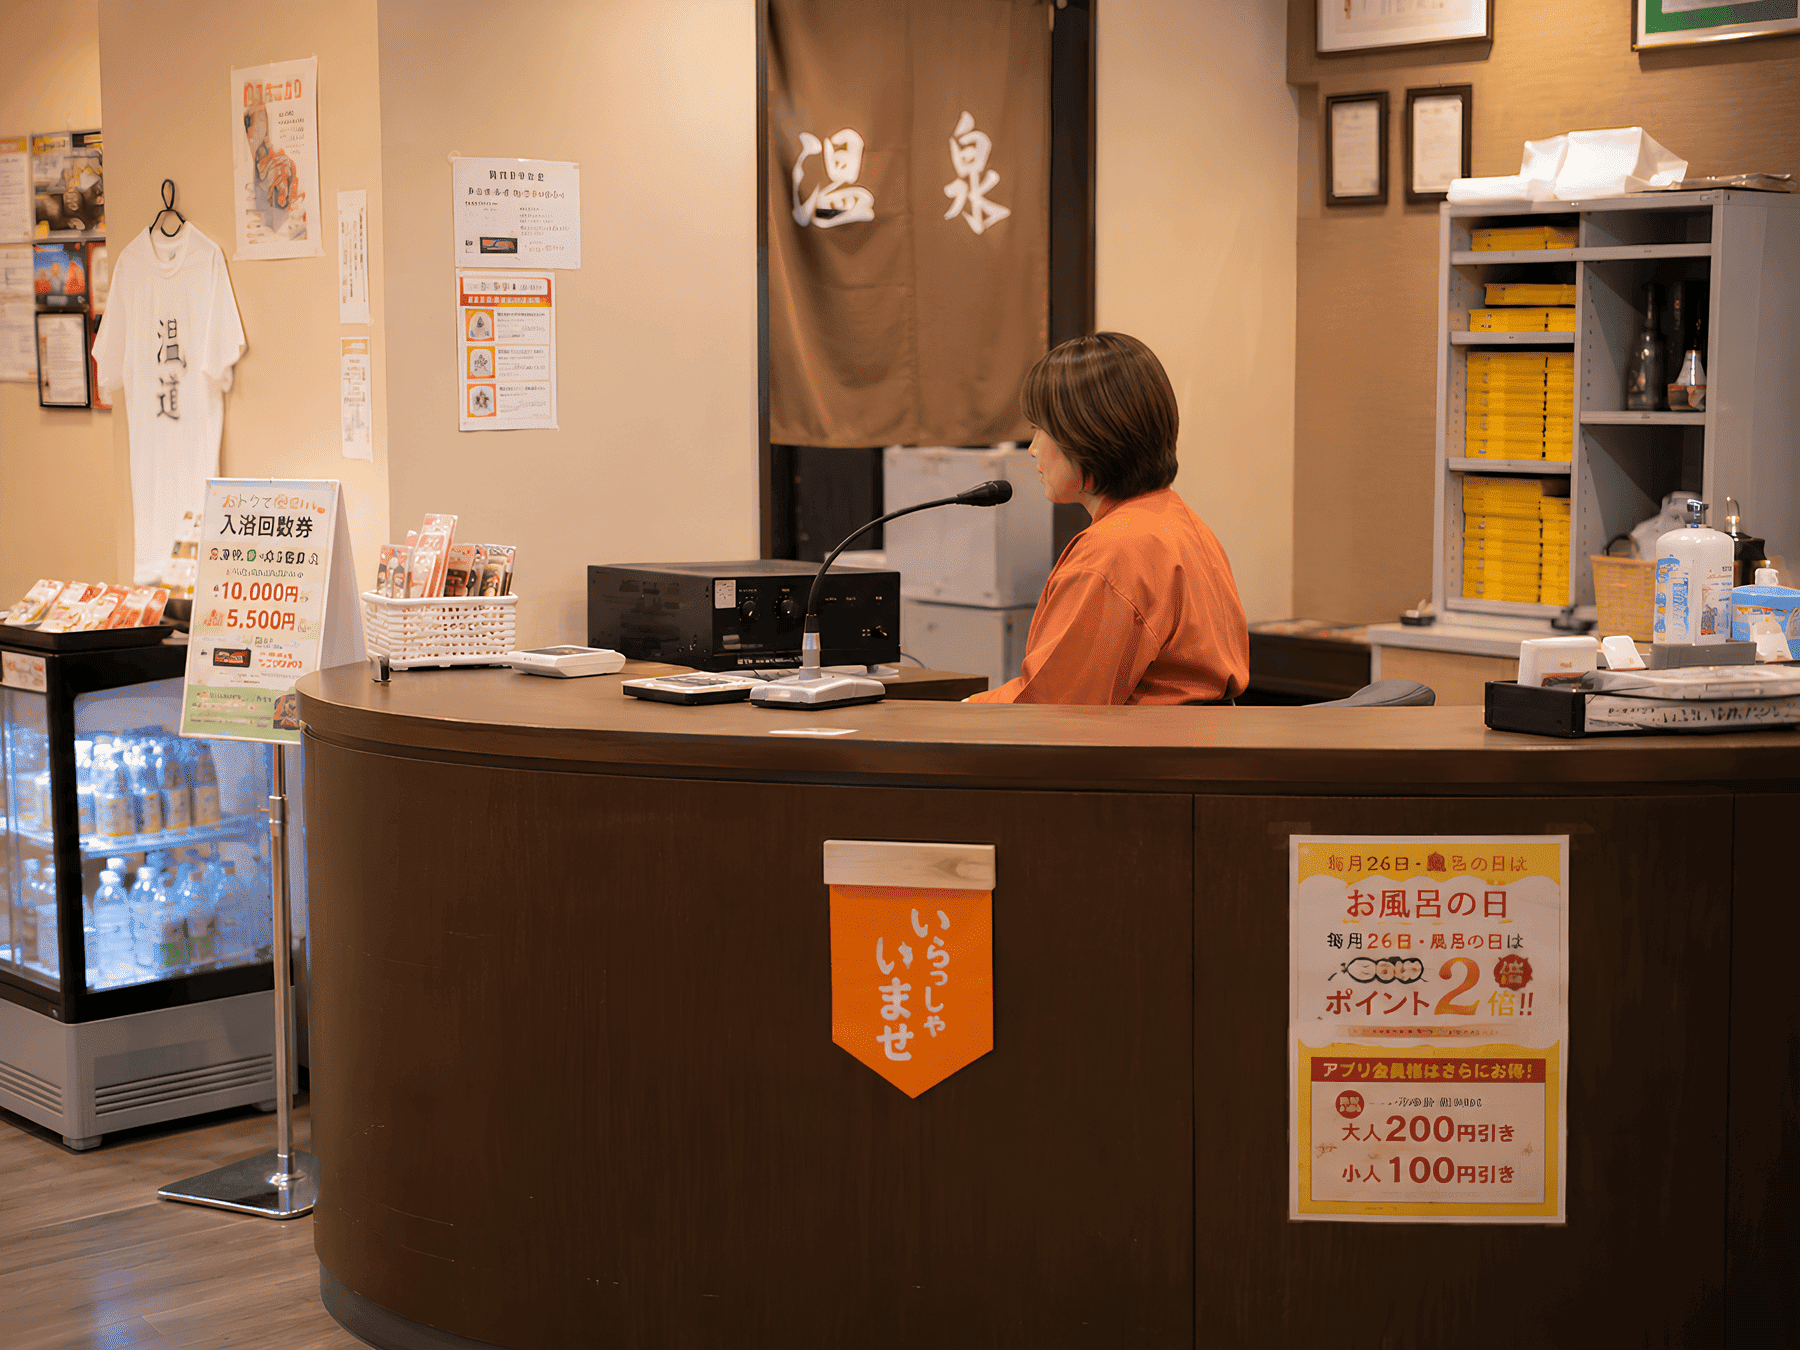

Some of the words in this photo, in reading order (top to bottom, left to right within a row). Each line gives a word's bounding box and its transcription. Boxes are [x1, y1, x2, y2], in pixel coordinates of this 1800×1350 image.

[792, 110, 1011, 235] 温泉
[220, 514, 313, 538] 入浴回数券
[1346, 889, 1506, 919] お風呂の日
[911, 908, 950, 1037] いらっしゃ
[876, 937, 914, 1061] いませ
[1341, 1115, 1515, 1143] 大人200円引き
[1341, 1156, 1515, 1184] 小人100円引き
